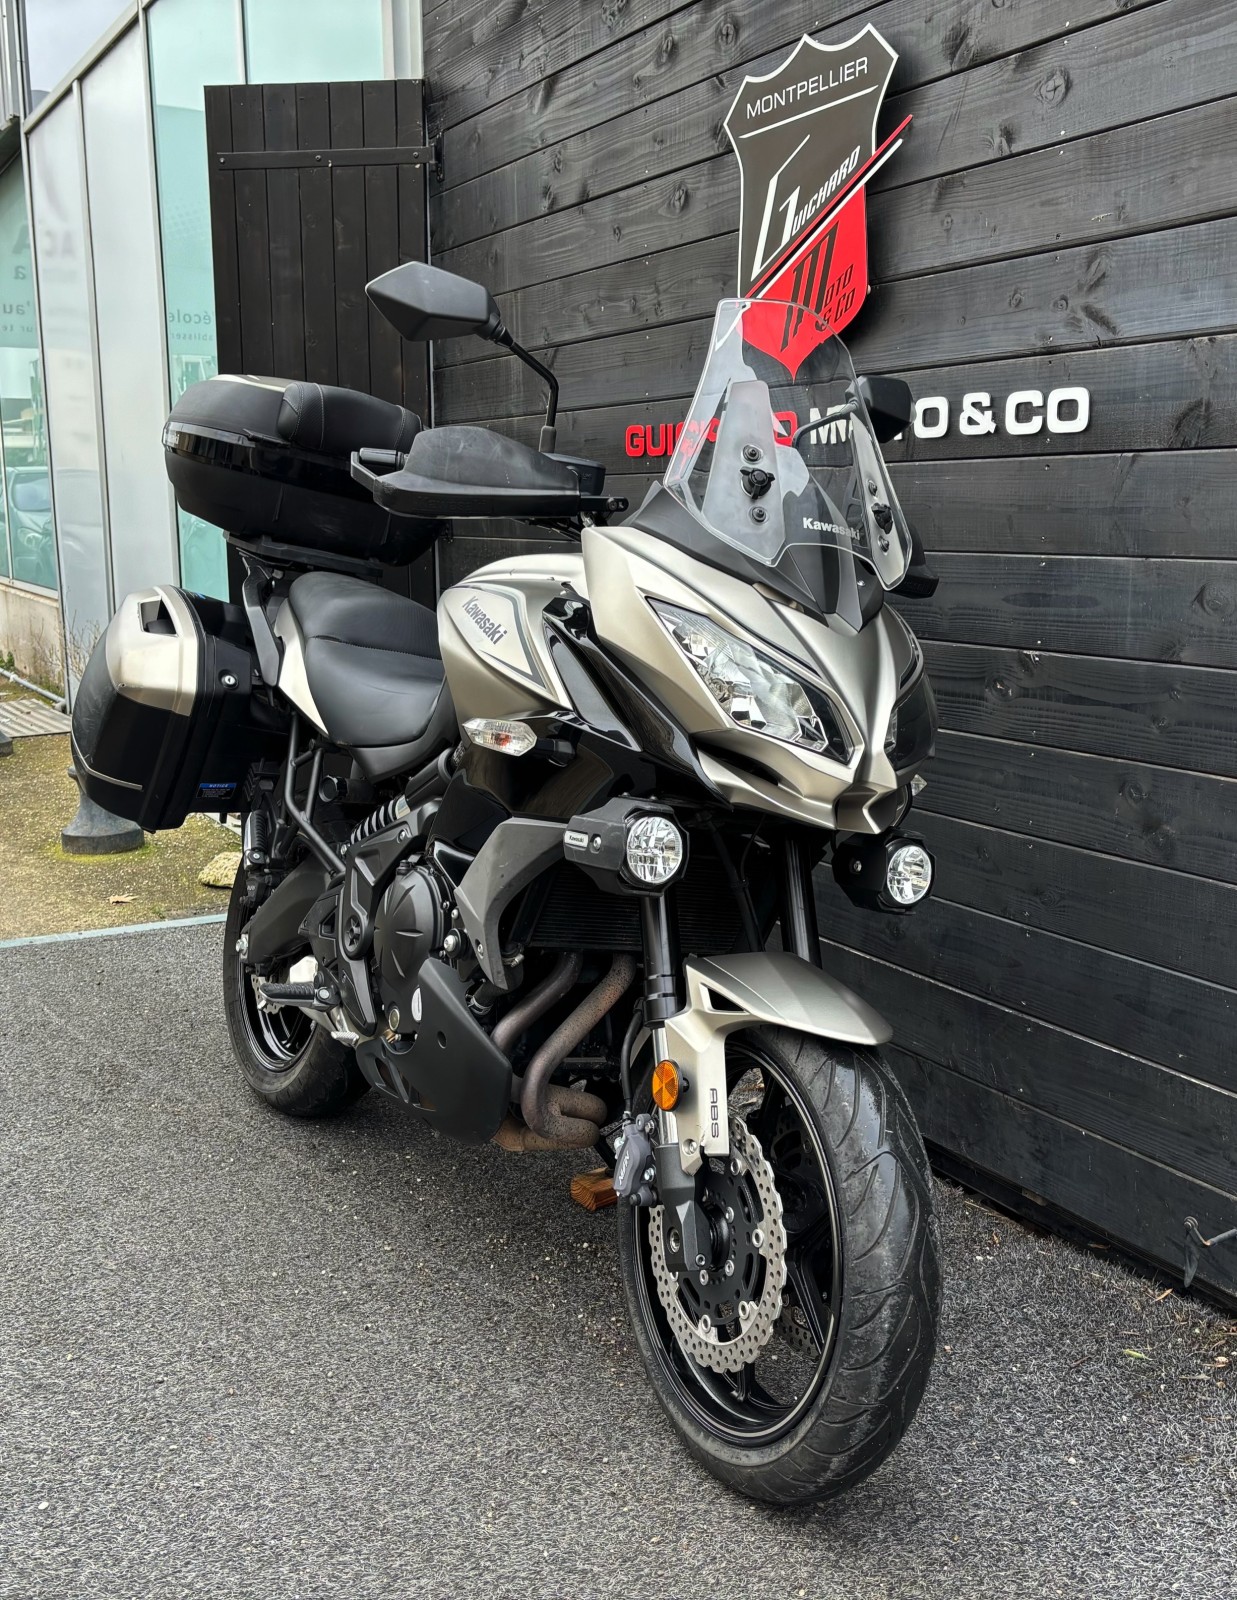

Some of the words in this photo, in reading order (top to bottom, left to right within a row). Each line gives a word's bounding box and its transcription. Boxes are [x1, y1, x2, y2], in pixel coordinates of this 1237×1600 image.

[746, 56, 870, 120] MONTPELLIER
[750, 134, 861, 282] GUICHARD
[833, 288, 856, 324] CO
[802, 516, 860, 541] Kawasaki
[462, 595, 508, 645] Kawasaki
[709, 1087, 720, 1139] ABS
